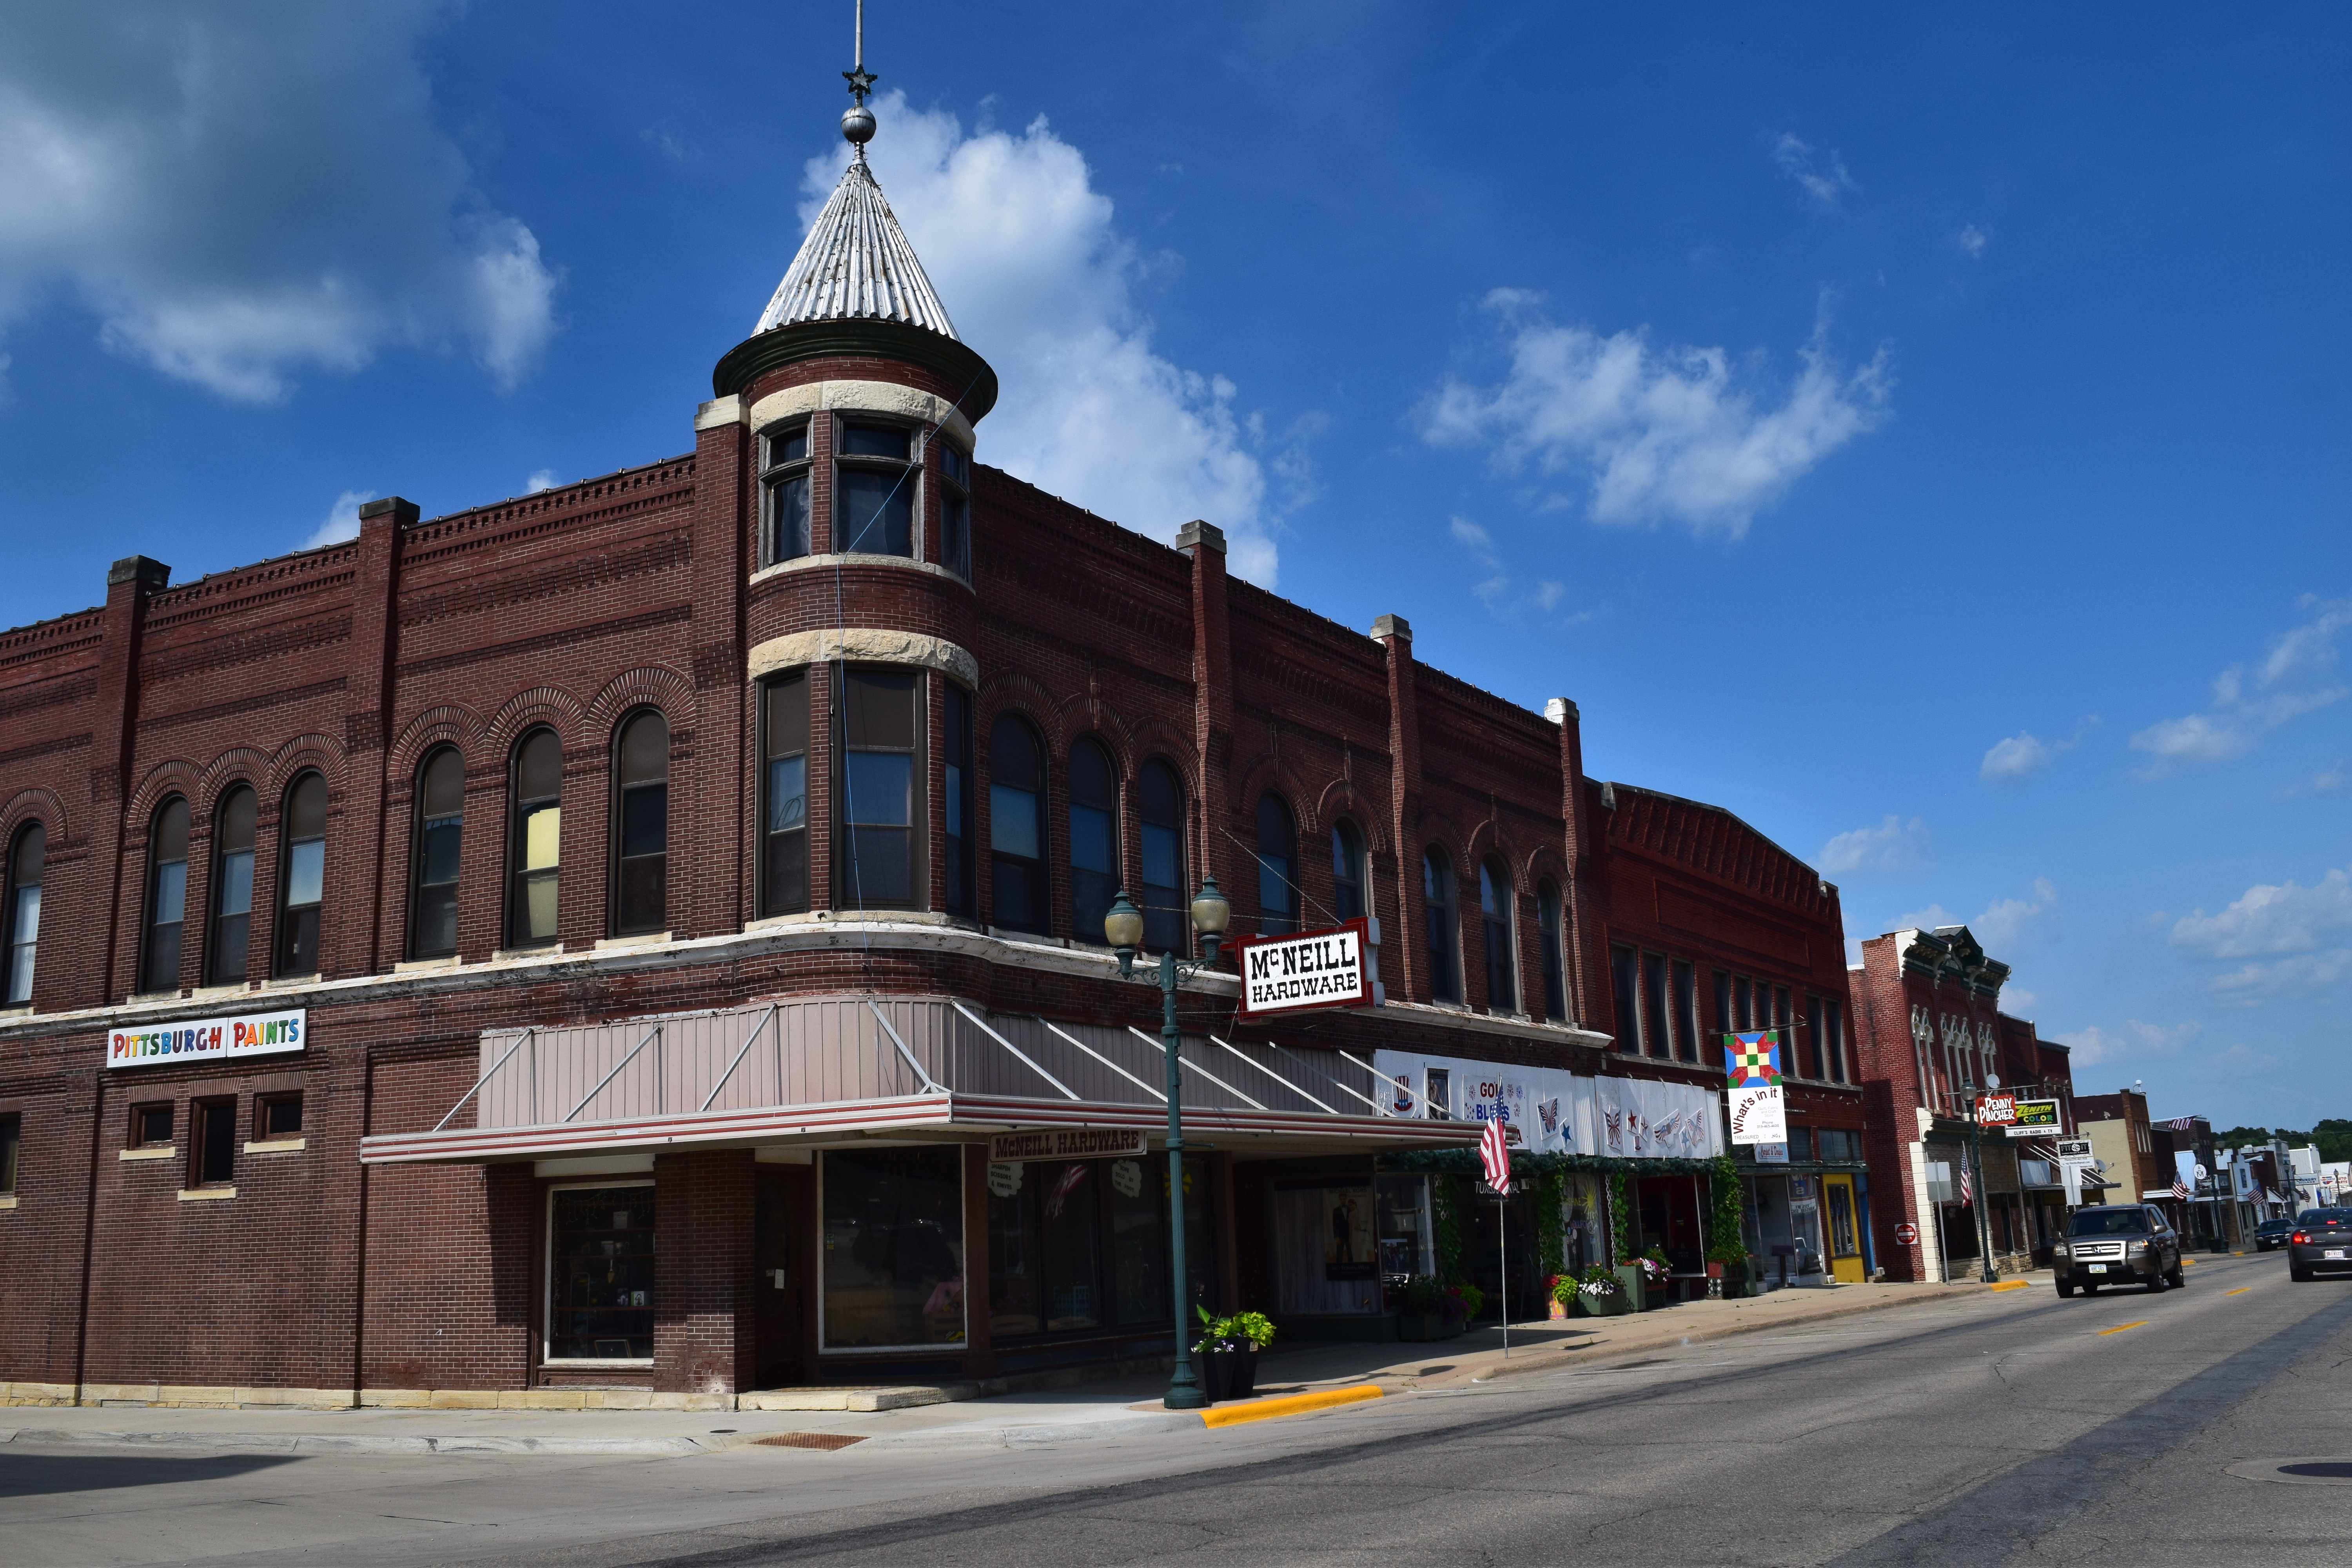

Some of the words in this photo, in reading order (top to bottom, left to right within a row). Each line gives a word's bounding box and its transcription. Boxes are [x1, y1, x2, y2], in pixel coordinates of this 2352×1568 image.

[1252, 972, 1357, 1003] HARDWARE
[113, 1027, 222, 1058] PITTSBURGH
[234, 1018, 299, 1047] PAINTS
[1476, 1104, 1510, 1121] BLS
[1733, 1098, 1755, 1134] What's
[1755, 1091, 1767, 1101] in
[1770, 1087, 1777, 1098] it
[1985, 1097, 2012, 1111] PENNY
[2016, 1105, 2053, 1118] ZENITH
[1979, 1107, 2014, 1123] PINCHER
[996, 1134, 1052, 1158] McNEILL
[1057, 1130, 1139, 1154] HARDWARE
[991, 1171, 1011, 1180] SCISSORS
